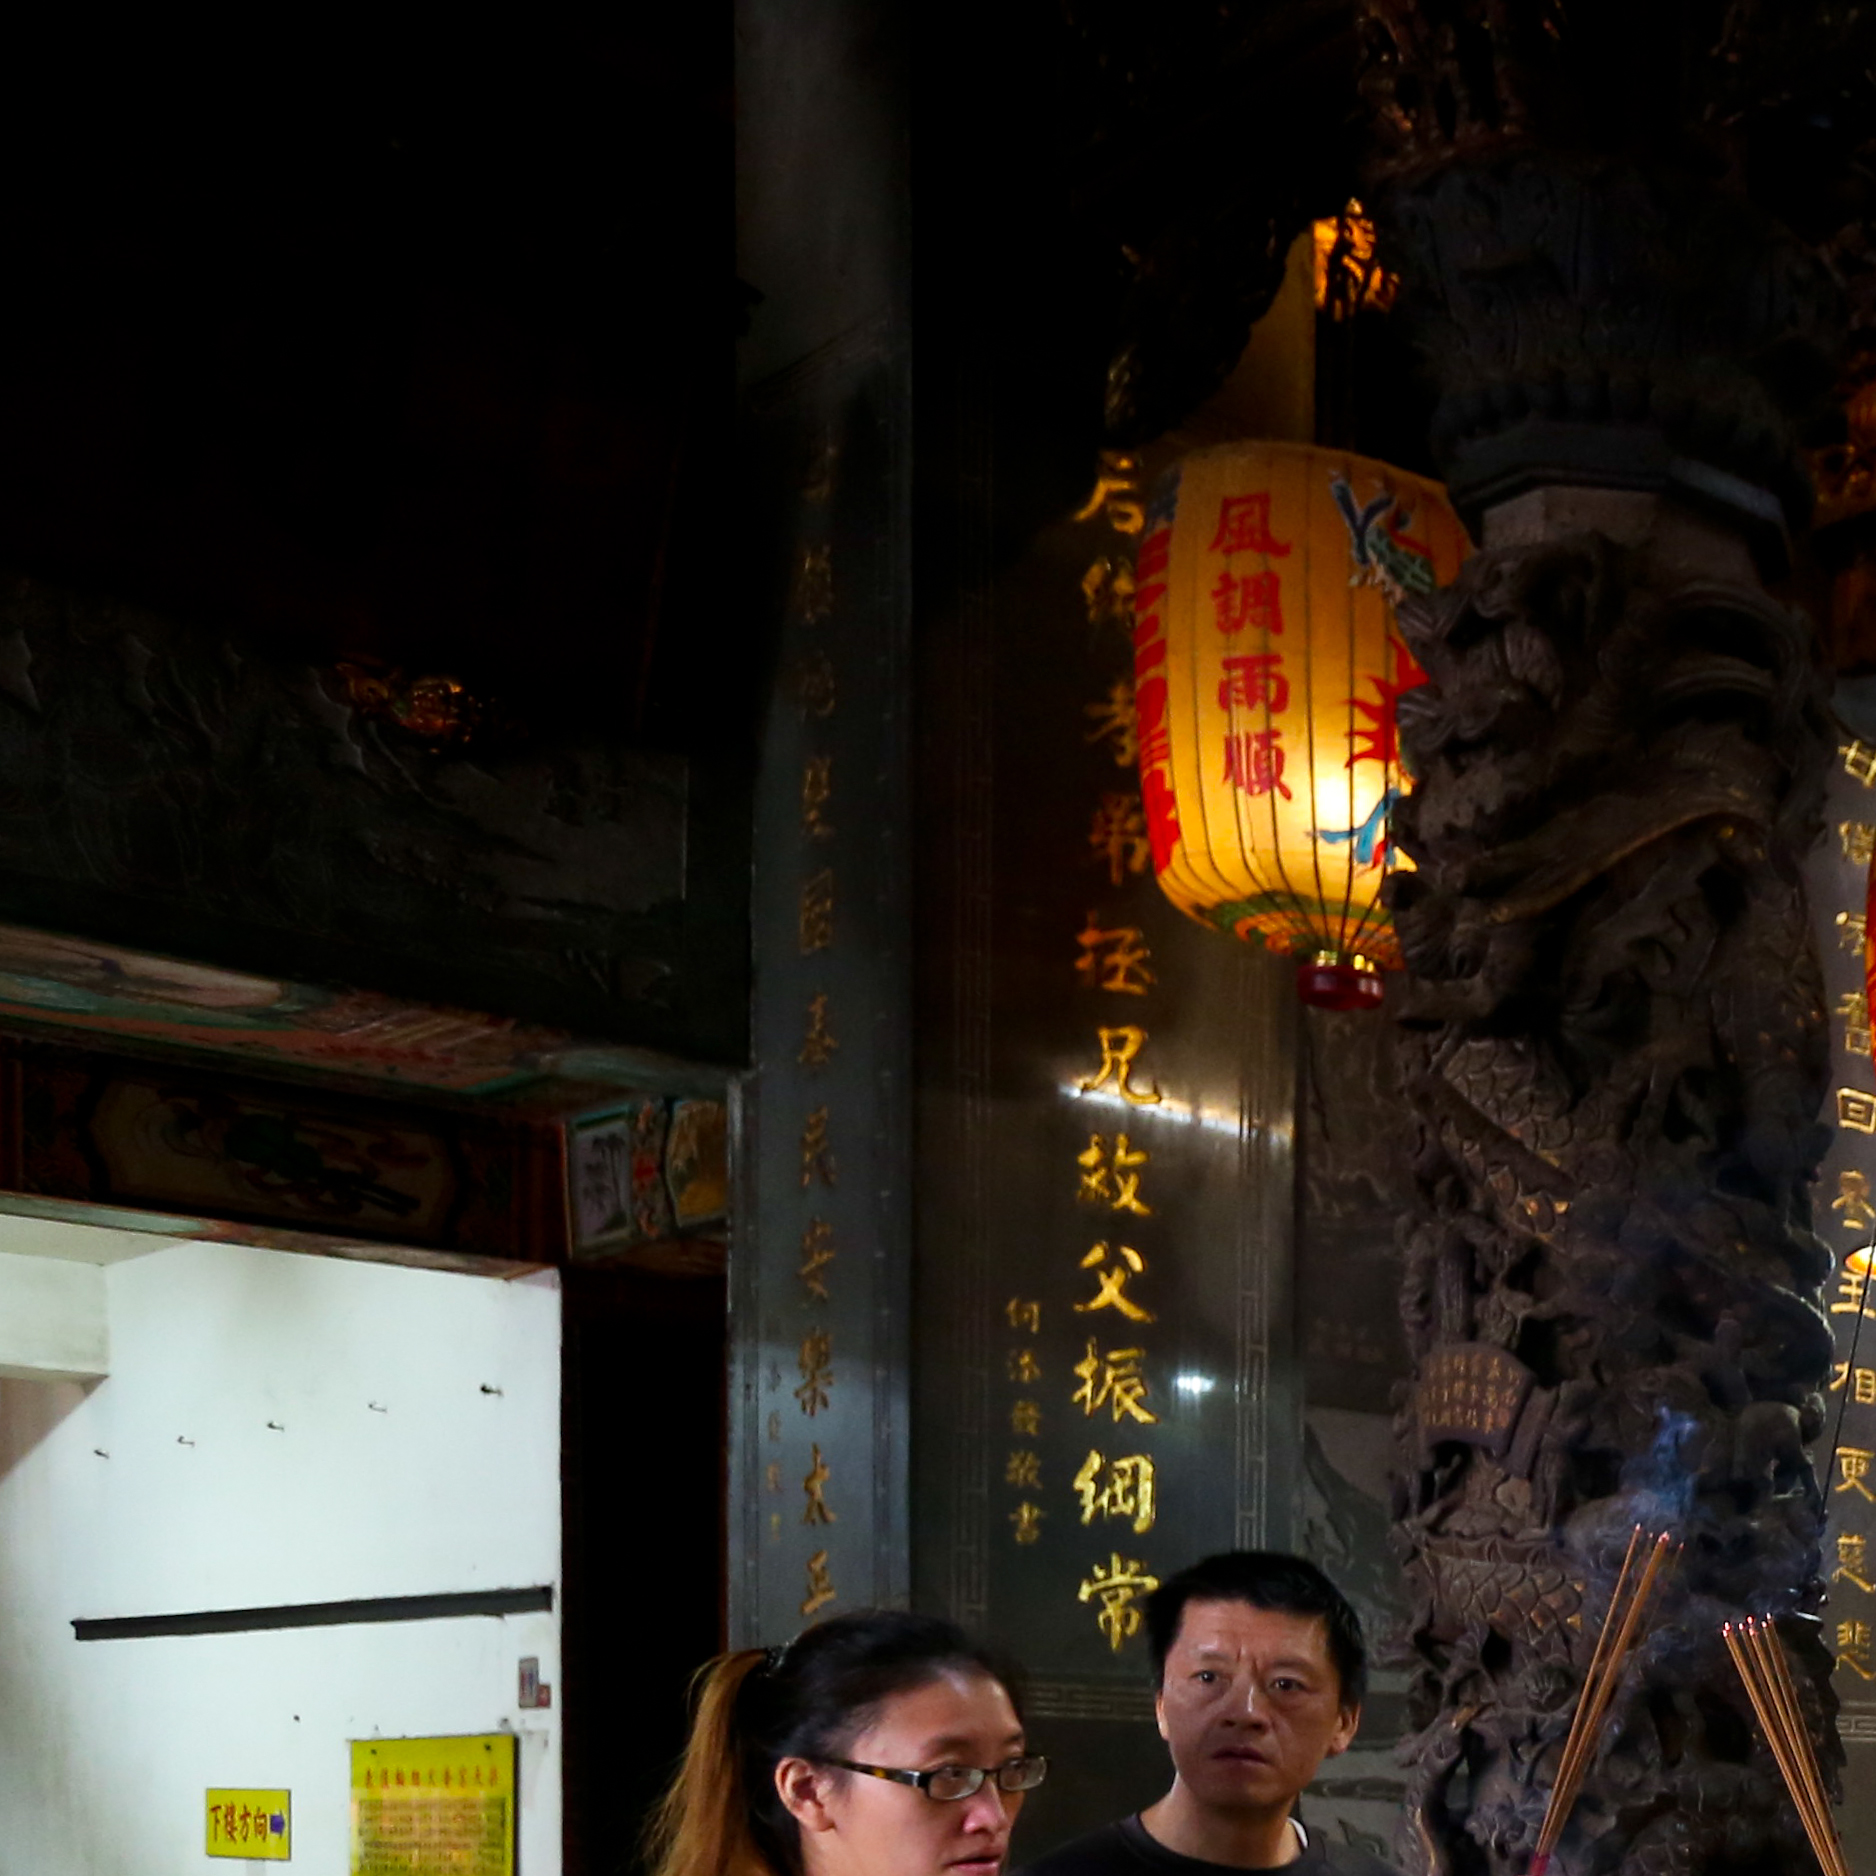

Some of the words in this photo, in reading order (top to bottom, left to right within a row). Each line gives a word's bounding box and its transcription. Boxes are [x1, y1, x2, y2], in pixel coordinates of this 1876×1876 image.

[1211, 491, 1292, 803] 風調雨順
[210, 1802, 269, 1844] 下樓方向
